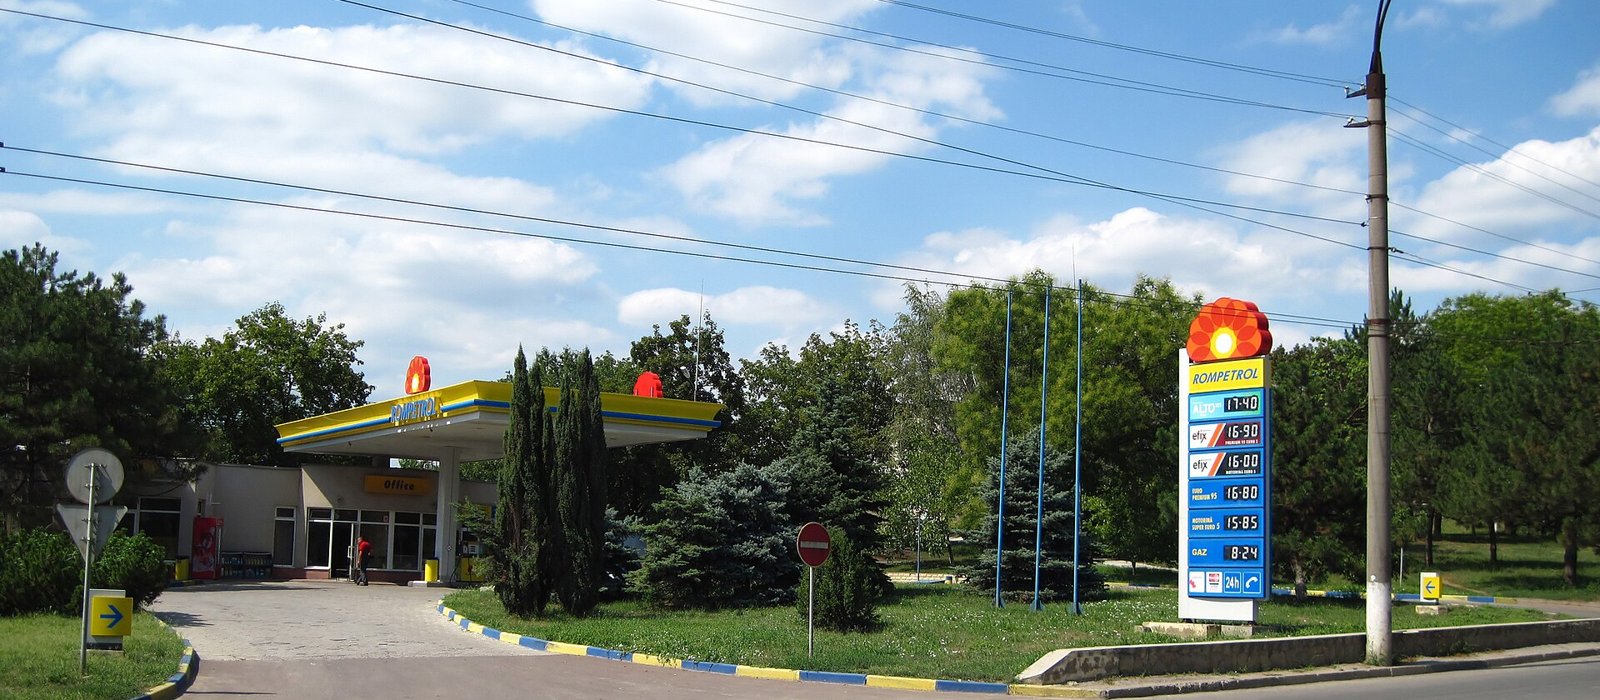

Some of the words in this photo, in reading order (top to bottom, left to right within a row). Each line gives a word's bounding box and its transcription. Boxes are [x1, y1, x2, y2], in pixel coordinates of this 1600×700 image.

[1192, 368, 1258, 384] ROMPETROL
[390, 397, 436, 423] ROMPETROL
[1192, 430, 1207, 443] efix
[1192, 459, 1208, 472] efix
[384, 479, 414, 491] Office
[1211, 492, 1218, 500] 95
[1216, 522, 1221, 530] 5
[1225, 576, 1240, 589] 24h
